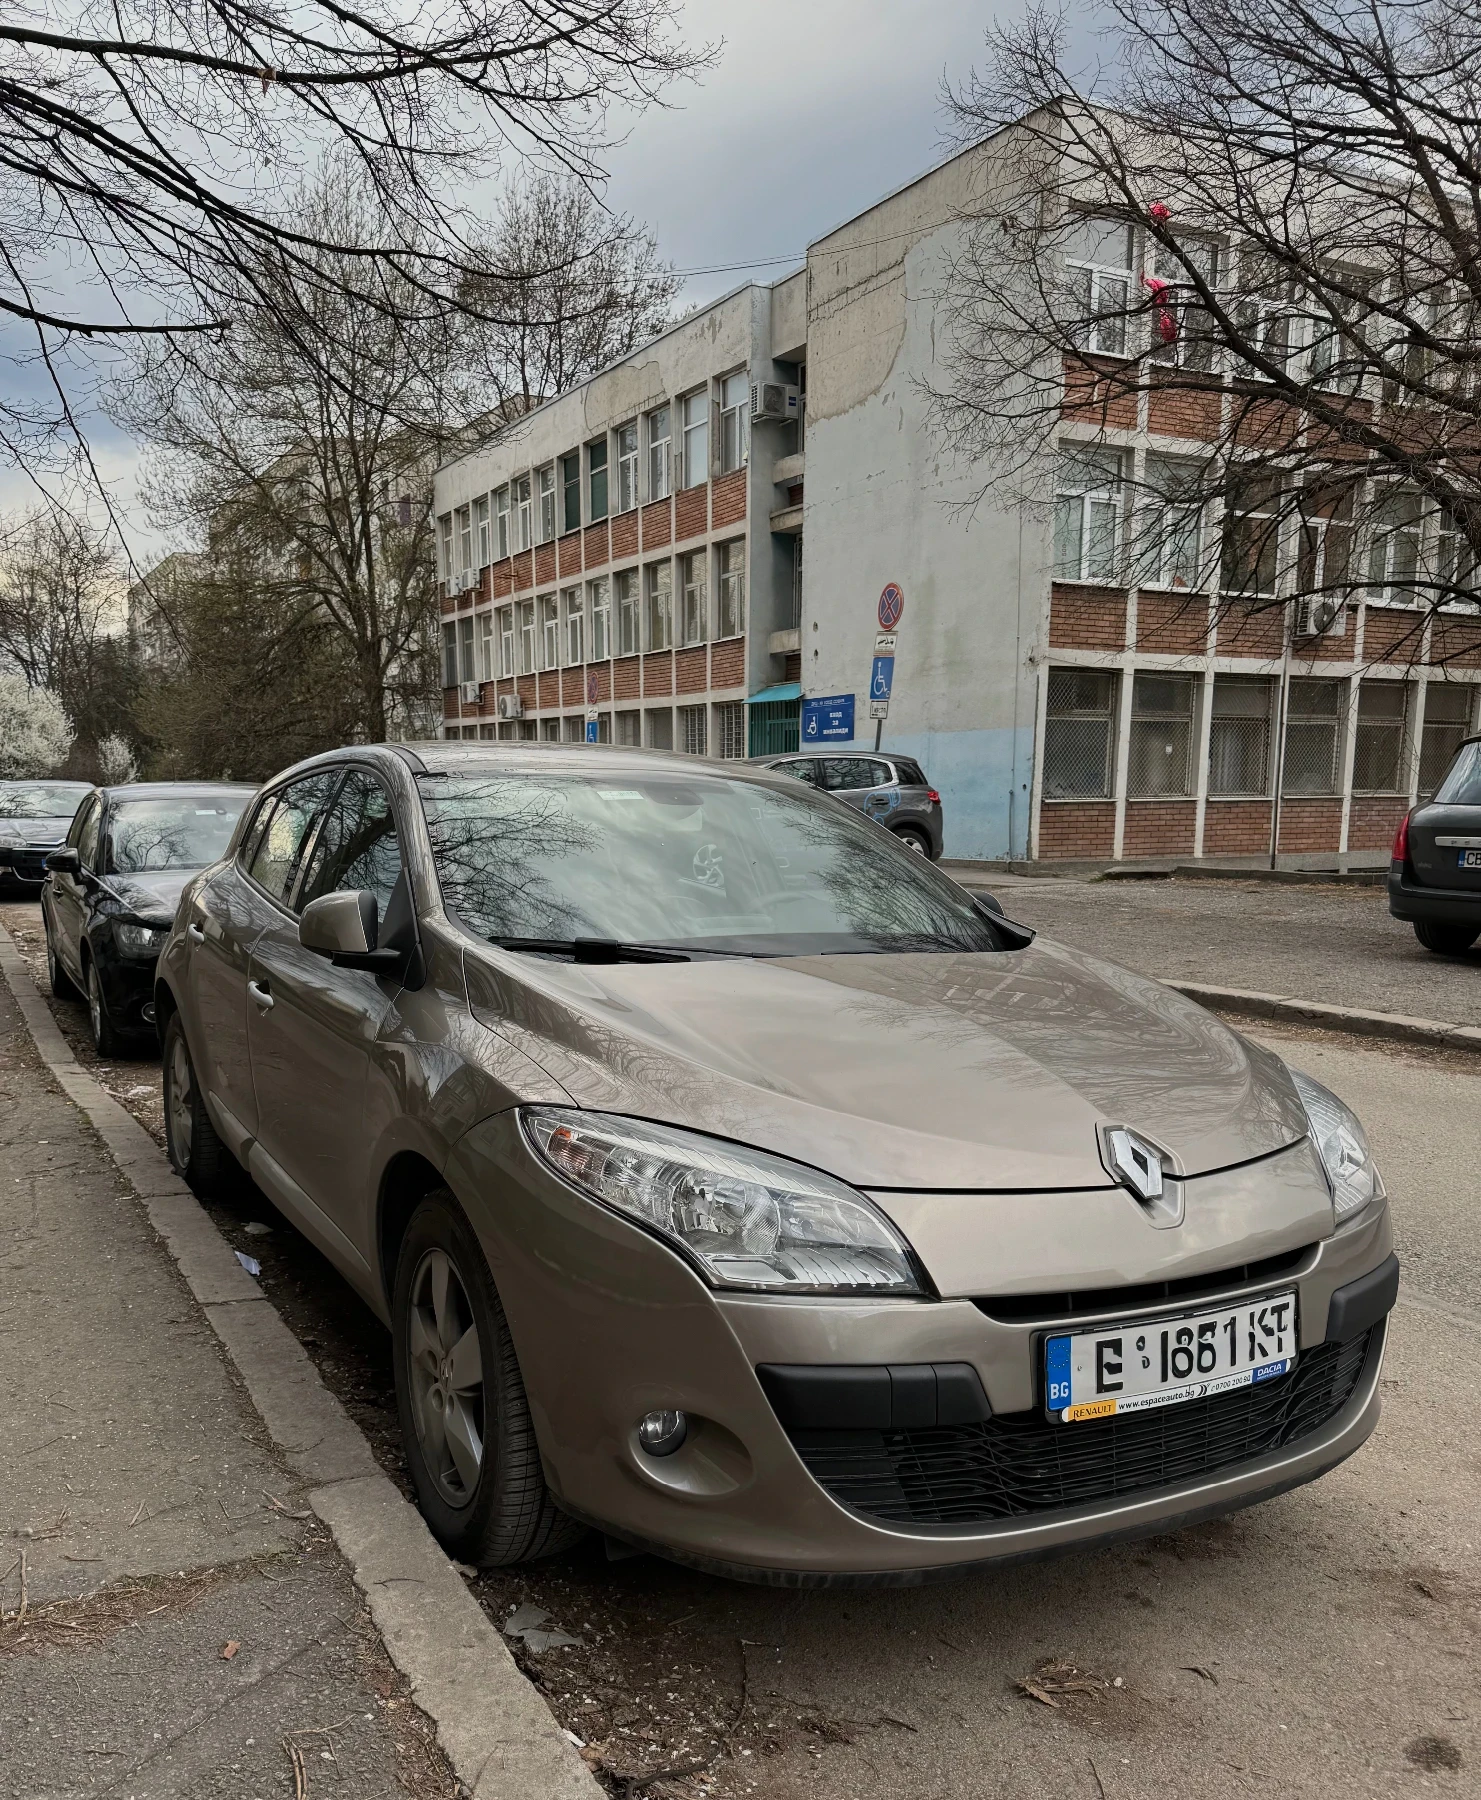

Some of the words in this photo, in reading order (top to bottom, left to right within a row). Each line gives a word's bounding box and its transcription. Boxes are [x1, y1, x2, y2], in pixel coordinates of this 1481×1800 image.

[1257, 1363, 1282, 1377] DACIA
[1050, 1381, 1069, 1399] BG
[1118, 1389, 1195, 1410] www.espaceauto.bg
[1073, 1404, 1112, 1418] RENAULT
